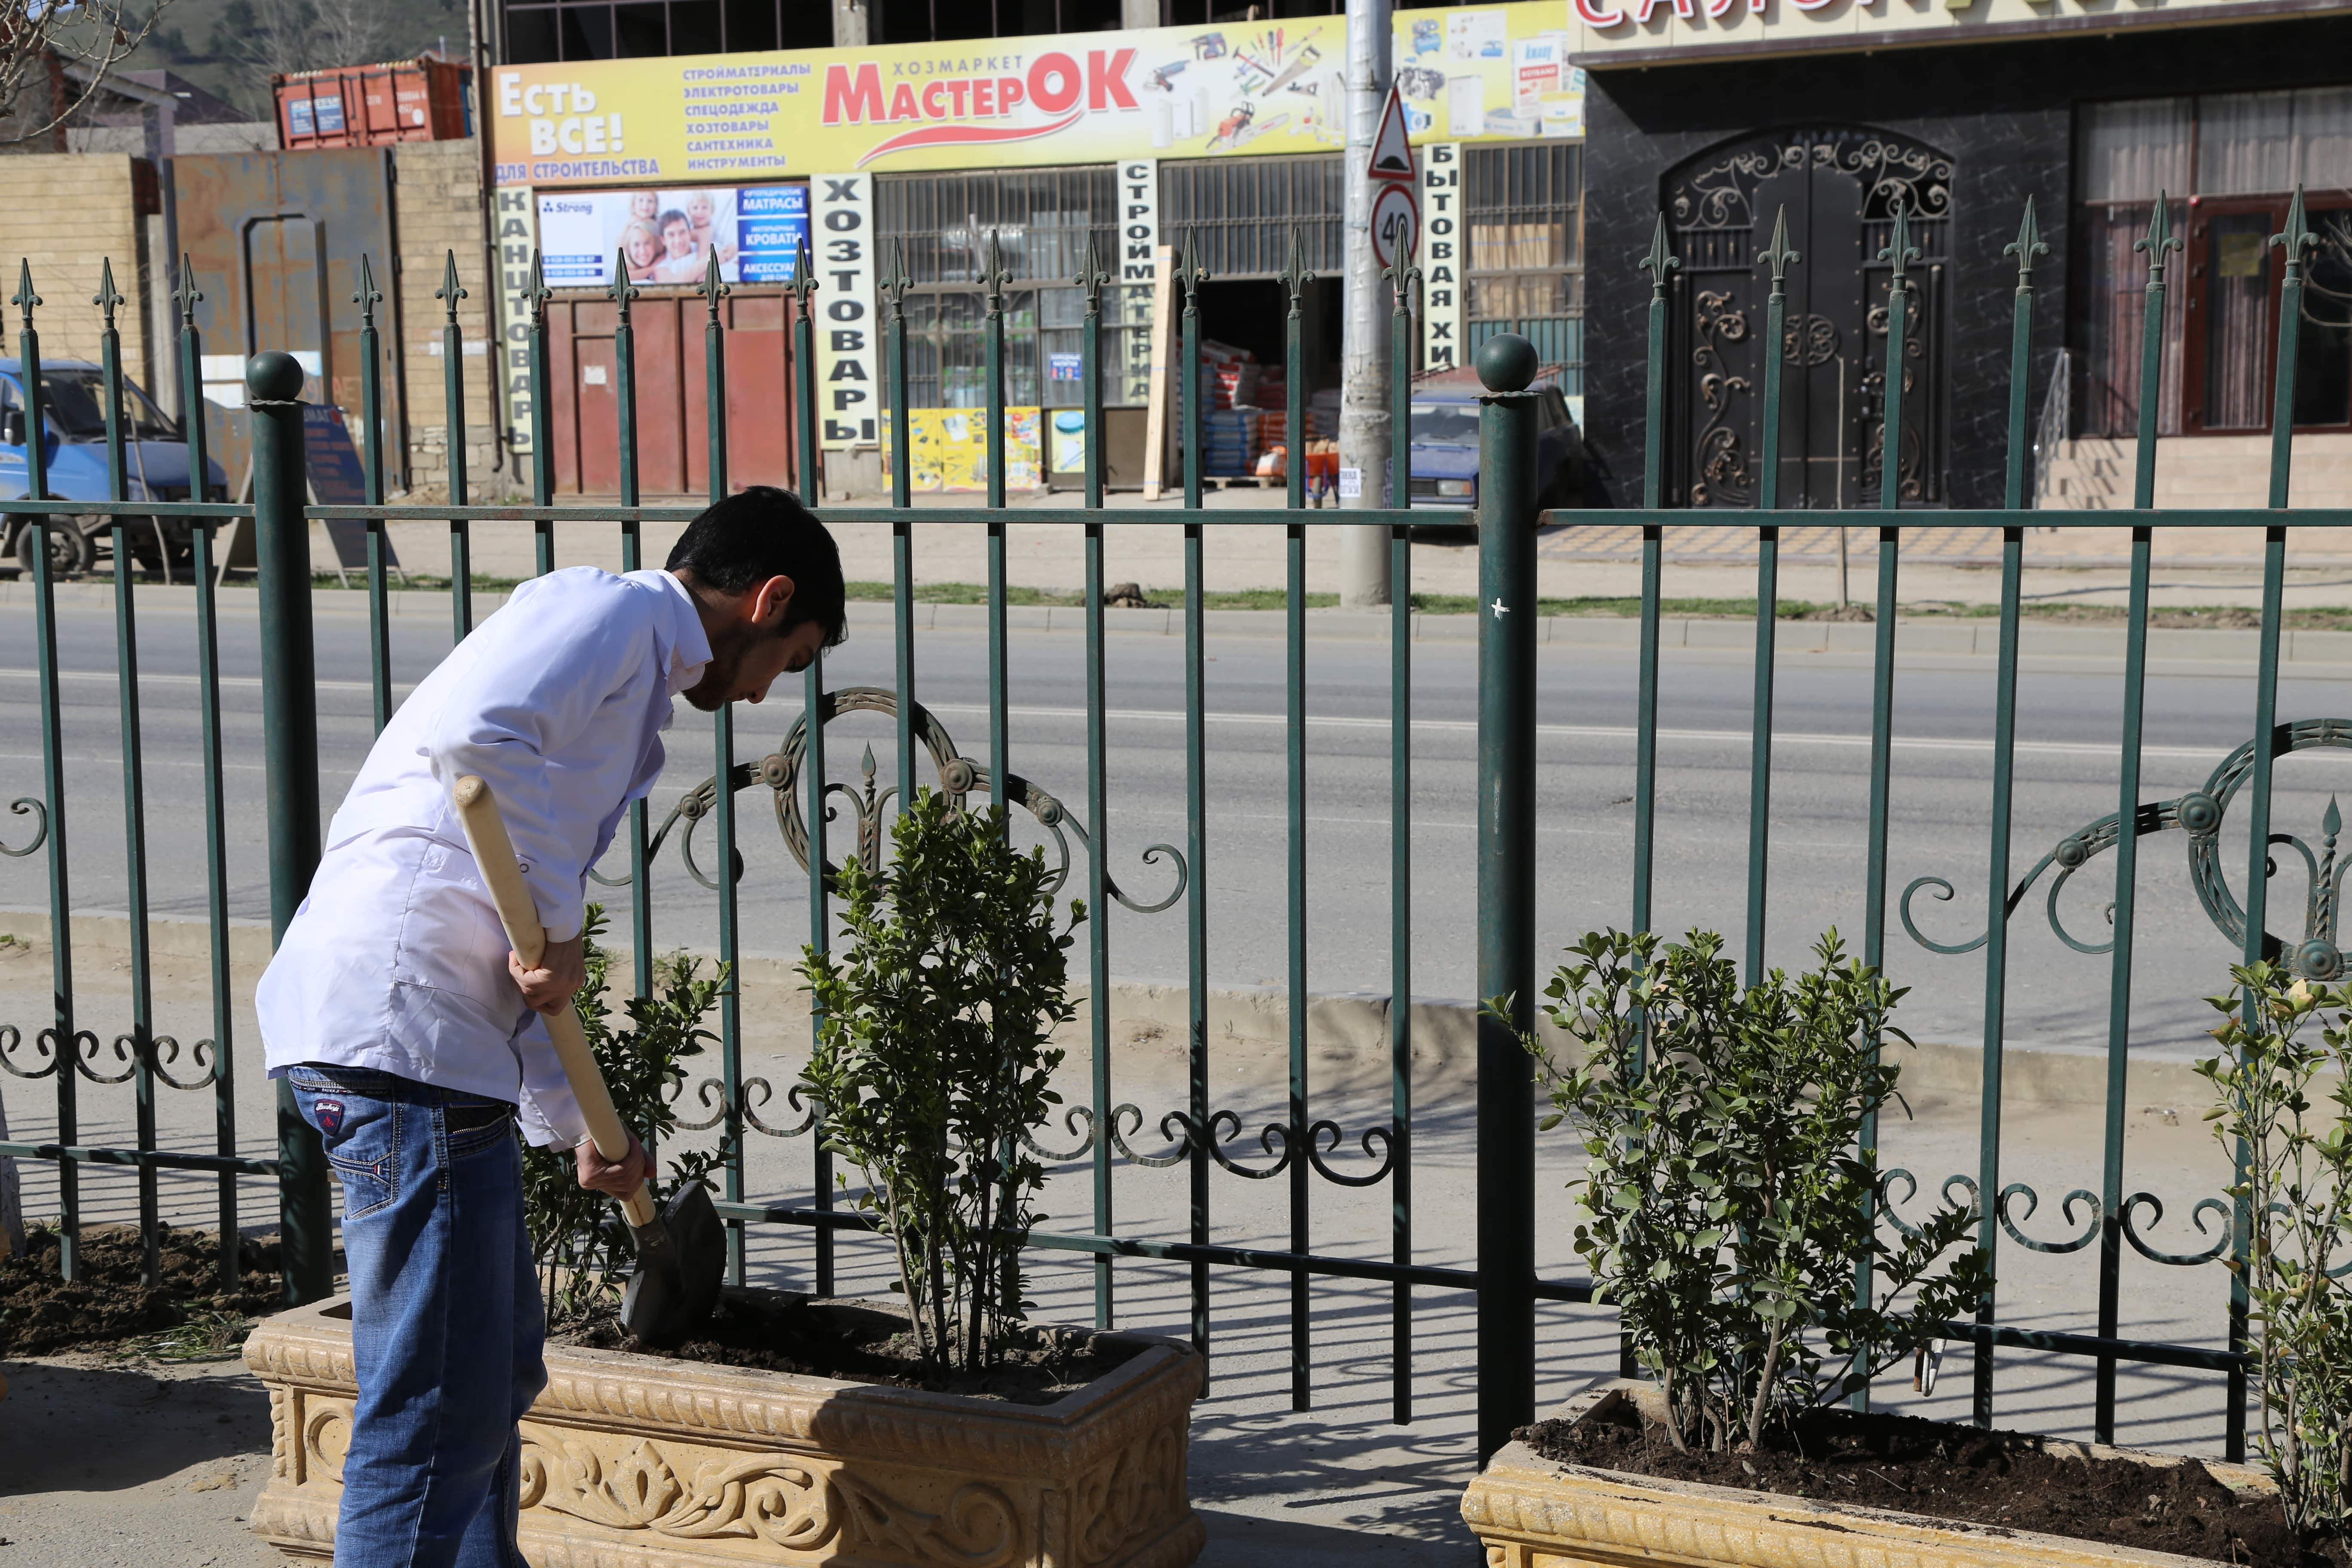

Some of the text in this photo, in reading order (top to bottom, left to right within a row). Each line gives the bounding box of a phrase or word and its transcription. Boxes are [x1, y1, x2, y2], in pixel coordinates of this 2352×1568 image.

[683, 63, 811, 80] СТРОЙМАТЕРИАЛЫ
[893, 55, 1023, 76] ХОЗМАРКЕТ
[683, 83, 799, 98] ЭЛЕКТРОТОВАРЫ
[685, 101, 779, 116] СПЕЦОДЕЖДА
[530, 113, 624, 156] ВСЕ!
[686, 120, 769, 134] ХОЗТОВАРЫ
[687, 138, 773, 151] САНТЕХНИКА
[688, 155, 786, 169] ИНСТРУМЕНТЫ
[495, 159, 659, 184] ДЛЯ СТРОИТЕЛЬСТВА
[556, 202, 593, 215] Strong
[743, 197, 803, 210] МАТРАСЫ
[1426, 146, 1457, 306] БЫТОВАЯ
[745, 232, 802, 246] КРОВАТИ
[823, 178, 875, 441] ХОЗТОВАРЫ
